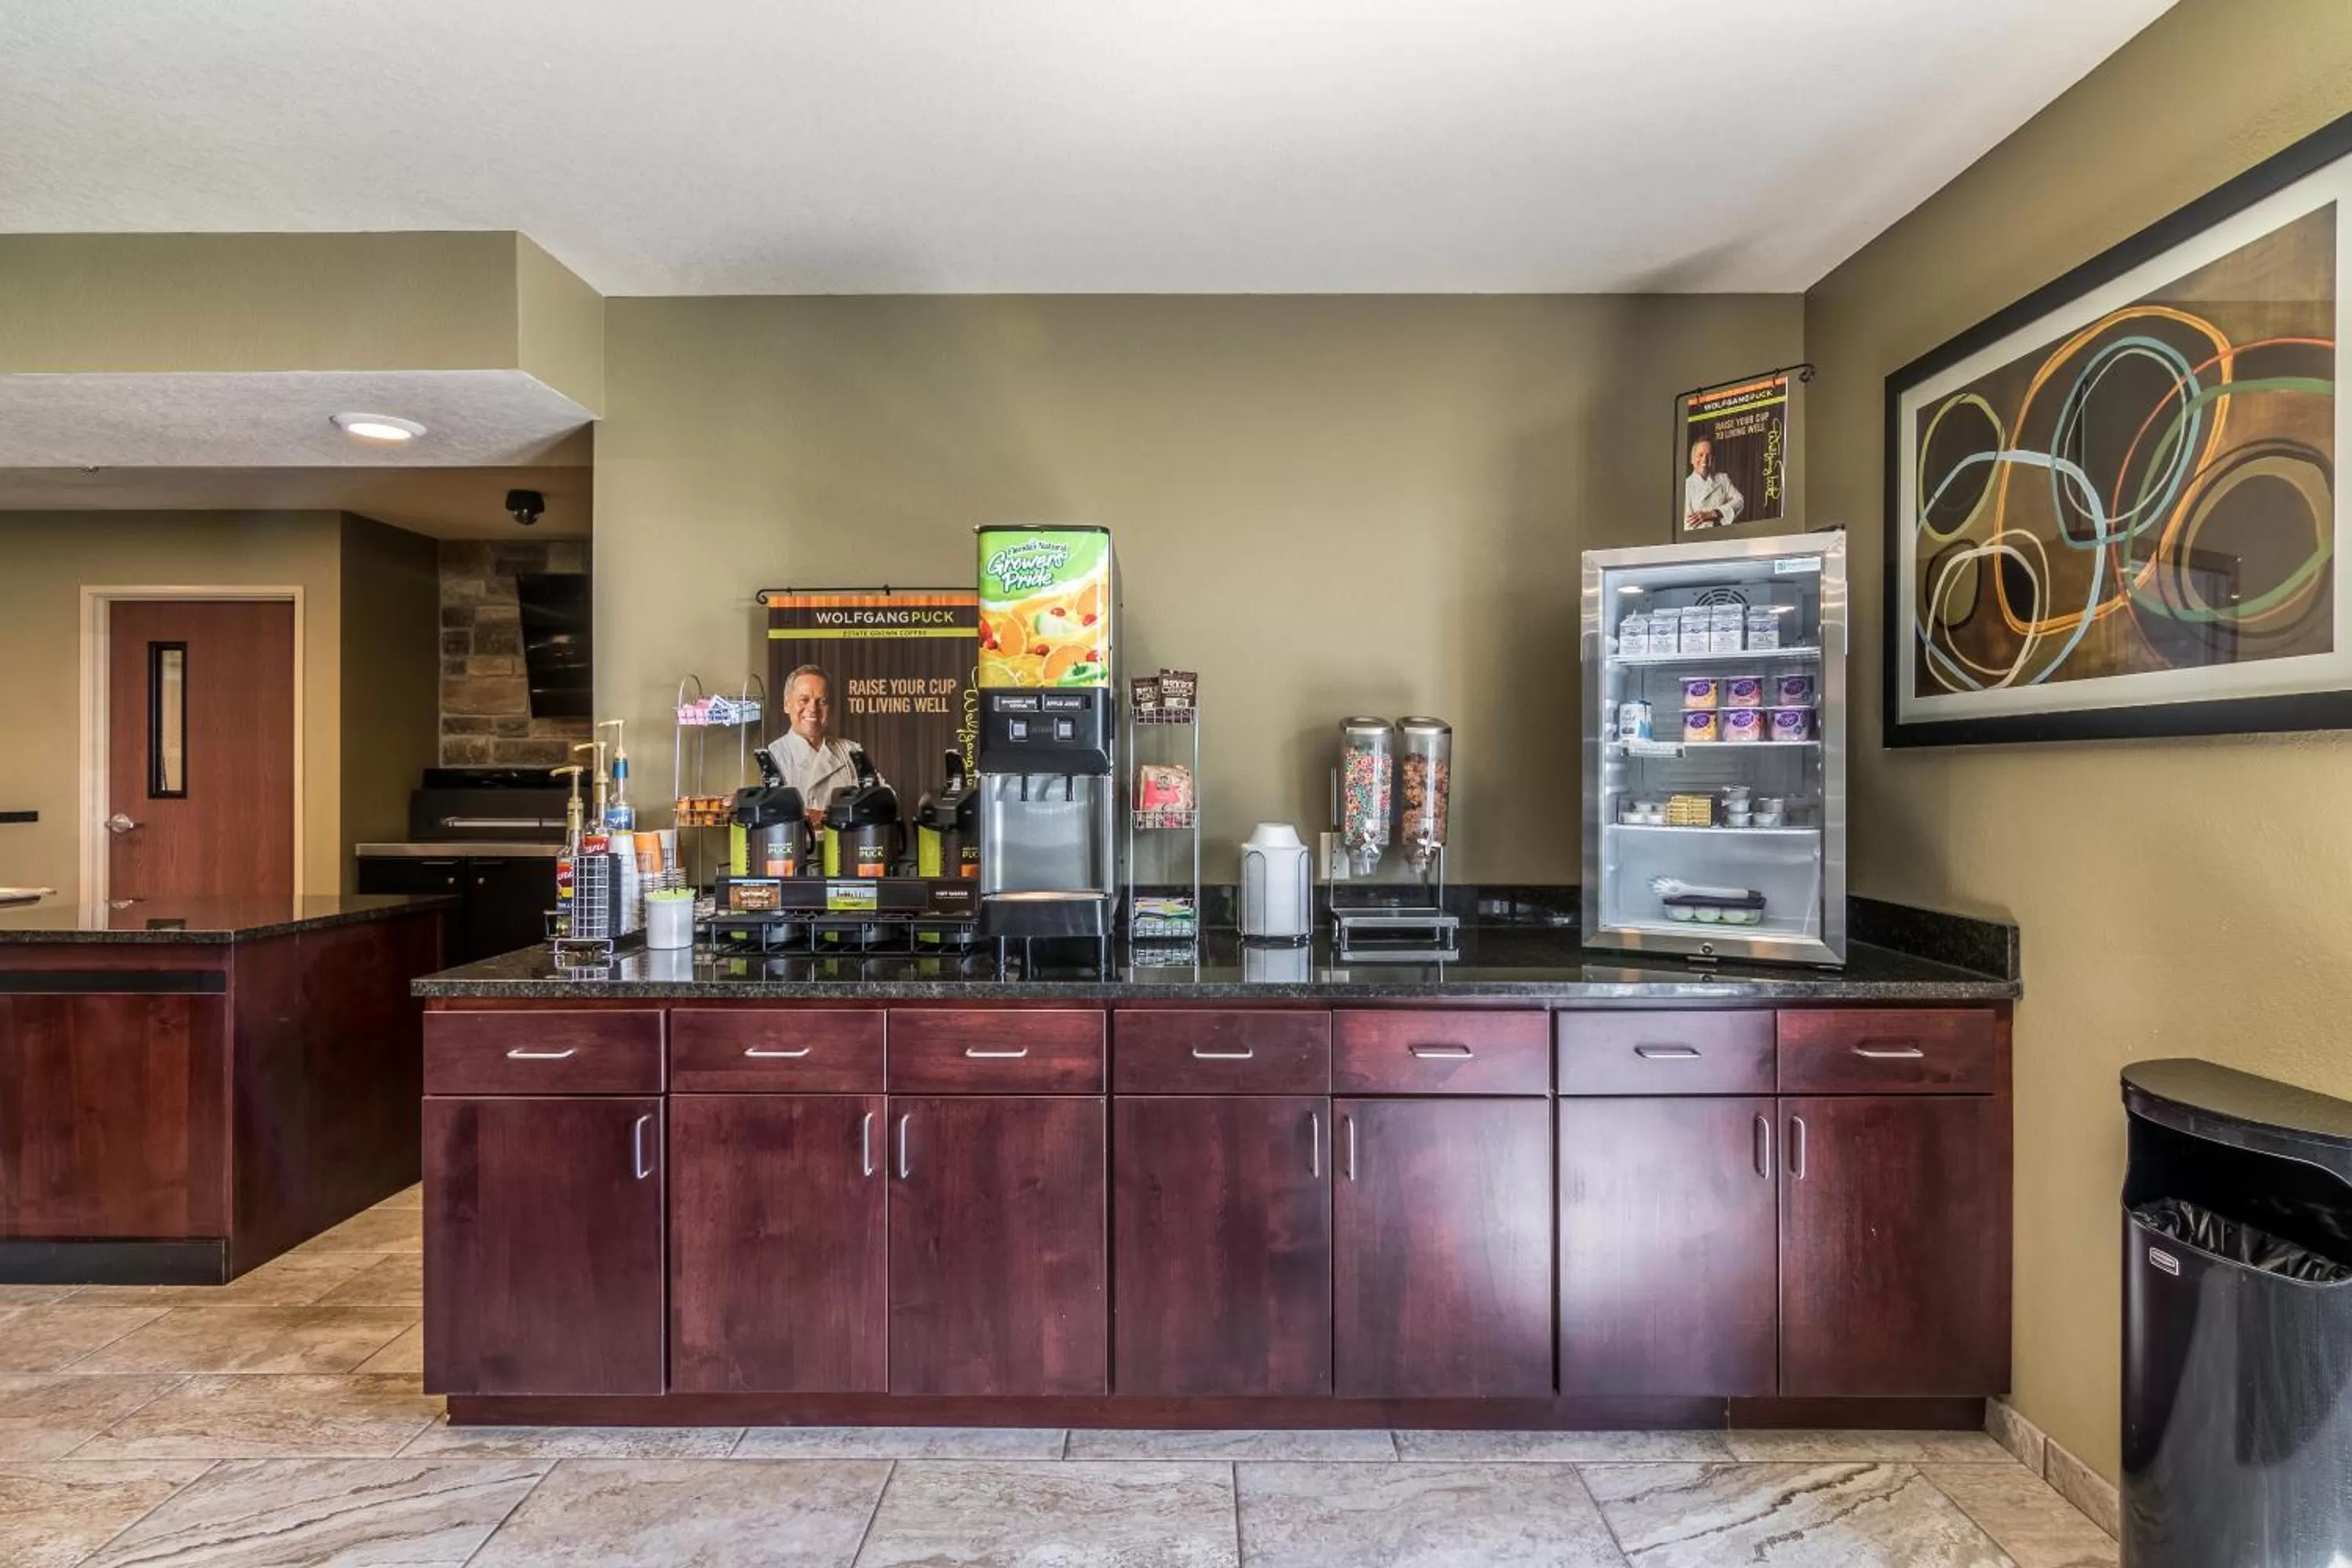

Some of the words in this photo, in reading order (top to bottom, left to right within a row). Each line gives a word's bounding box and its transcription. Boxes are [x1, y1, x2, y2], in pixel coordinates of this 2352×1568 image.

[1001, 568, 1054, 593] Pride
[848, 678, 887, 695] RAISE
[890, 678, 927, 695] YOUR
[929, 678, 956, 695] CUP
[848, 697, 865, 713] TO
[868, 697, 912, 713] LIVING
[913, 697, 950, 713] WELL
